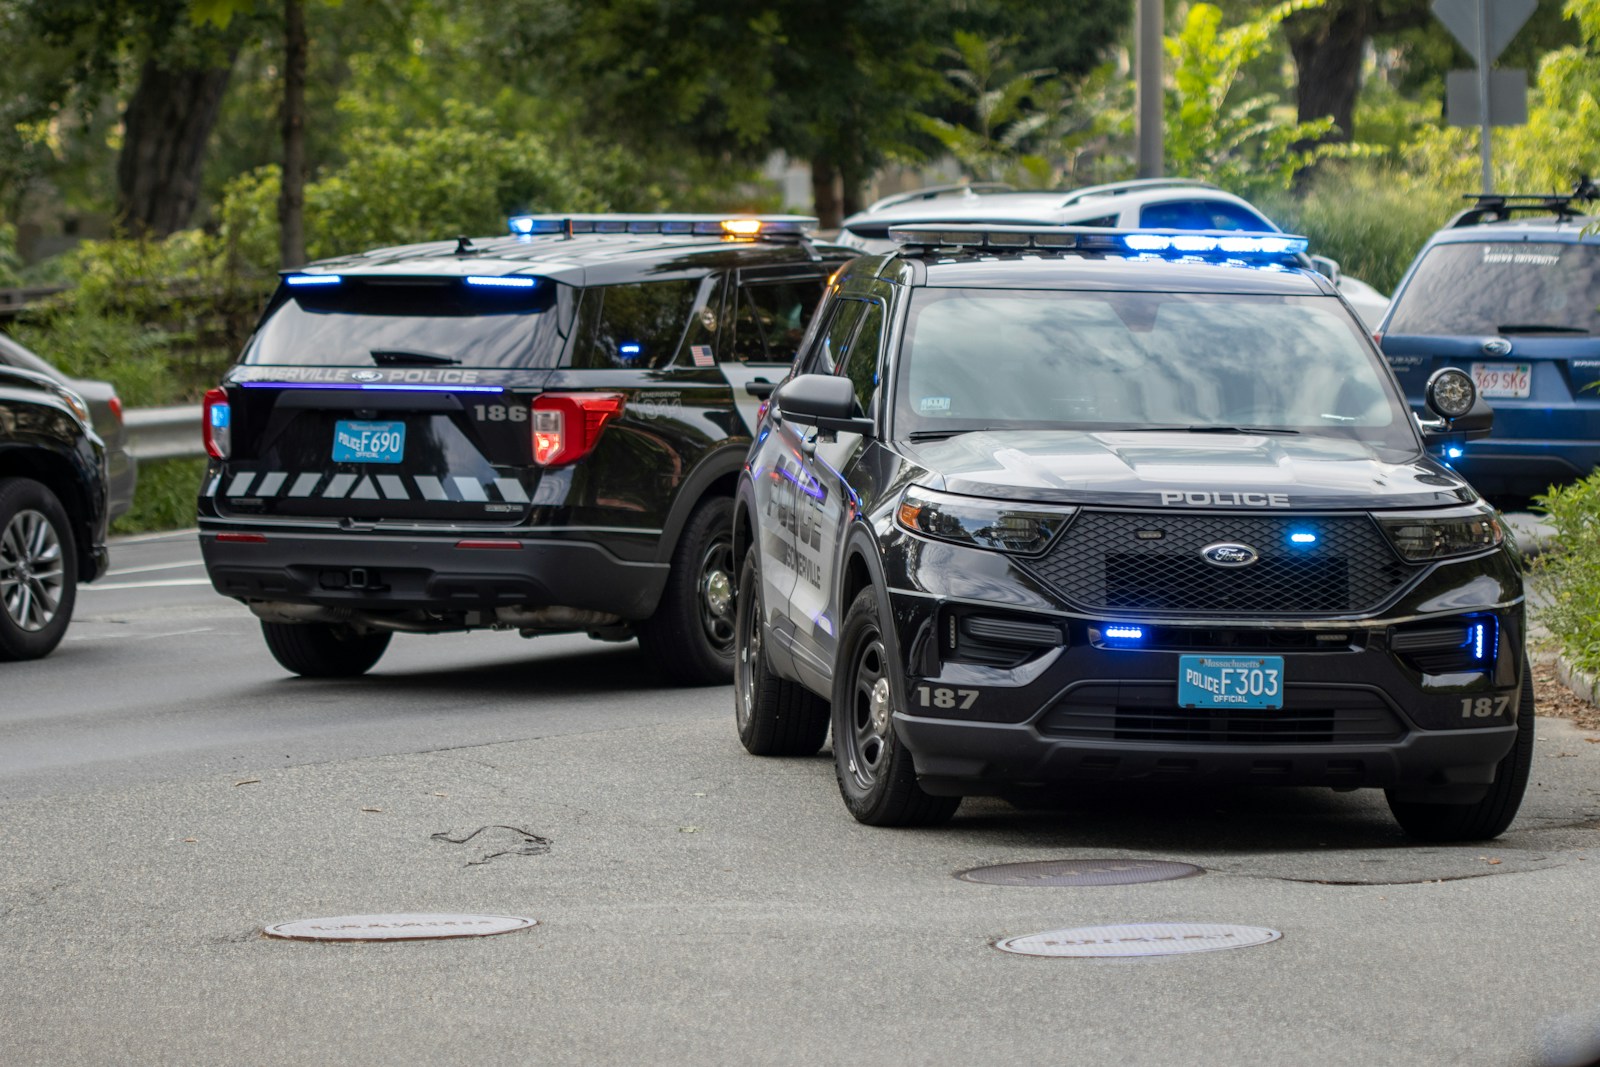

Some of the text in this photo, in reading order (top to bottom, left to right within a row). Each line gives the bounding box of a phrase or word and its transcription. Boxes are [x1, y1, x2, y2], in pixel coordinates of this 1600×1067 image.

[1514, 254, 1560, 265] UNIVERSITY
[388, 370, 479, 383] POLICE
[1475, 372, 1528, 390] 369 SK6
[474, 404, 527, 423] 186
[338, 431, 401, 453] POLICE F690
[1160, 490, 1291, 508] POLICE
[1214, 548, 1248, 562] Ford
[1203, 659, 1260, 669] Massachusetts
[1186, 668, 1279, 696] POLICE F303
[917, 686, 980, 710] 187
[1213, 695, 1248, 703] OFFICIAL
[1460, 695, 1510, 718] 187
